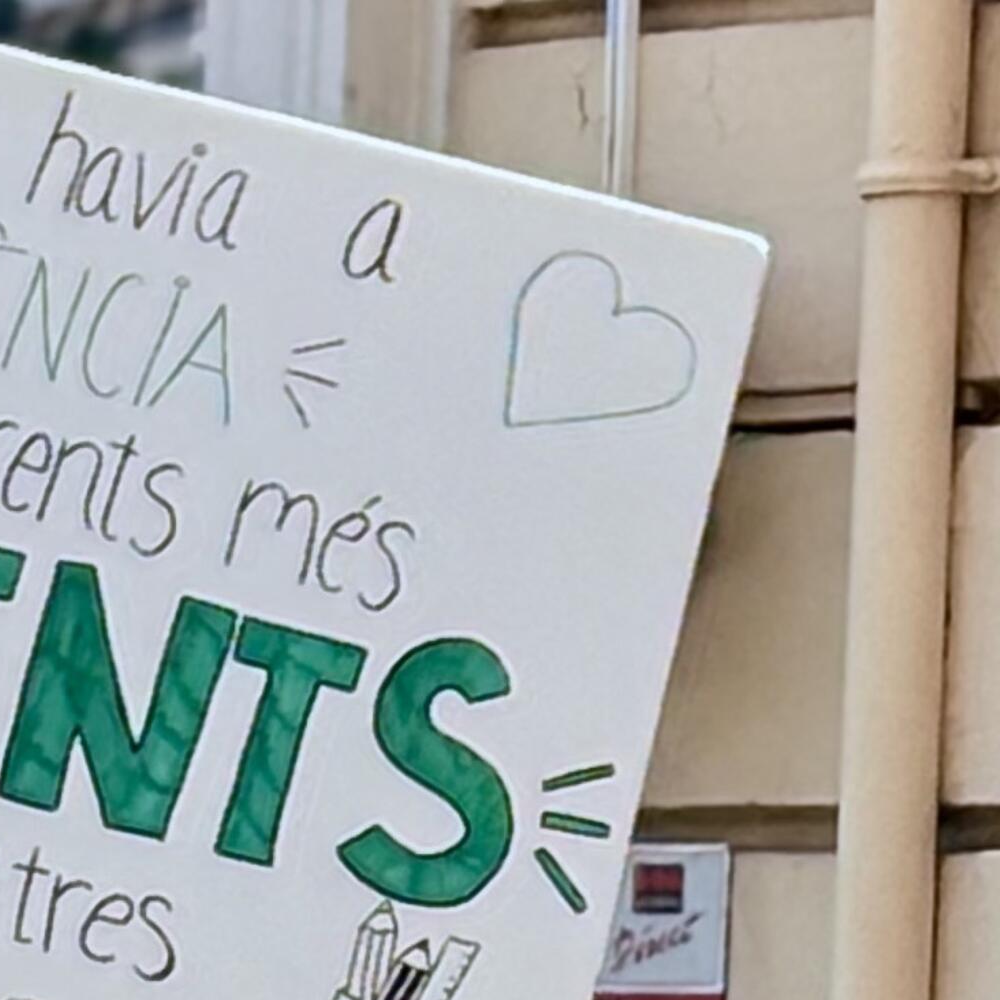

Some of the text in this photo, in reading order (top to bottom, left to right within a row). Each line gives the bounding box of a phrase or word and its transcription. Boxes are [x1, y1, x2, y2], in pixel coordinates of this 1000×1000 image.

[25, 90, 249, 250] havia
[343, 198, 404, 283] a
[224, 479, 416, 612] més
